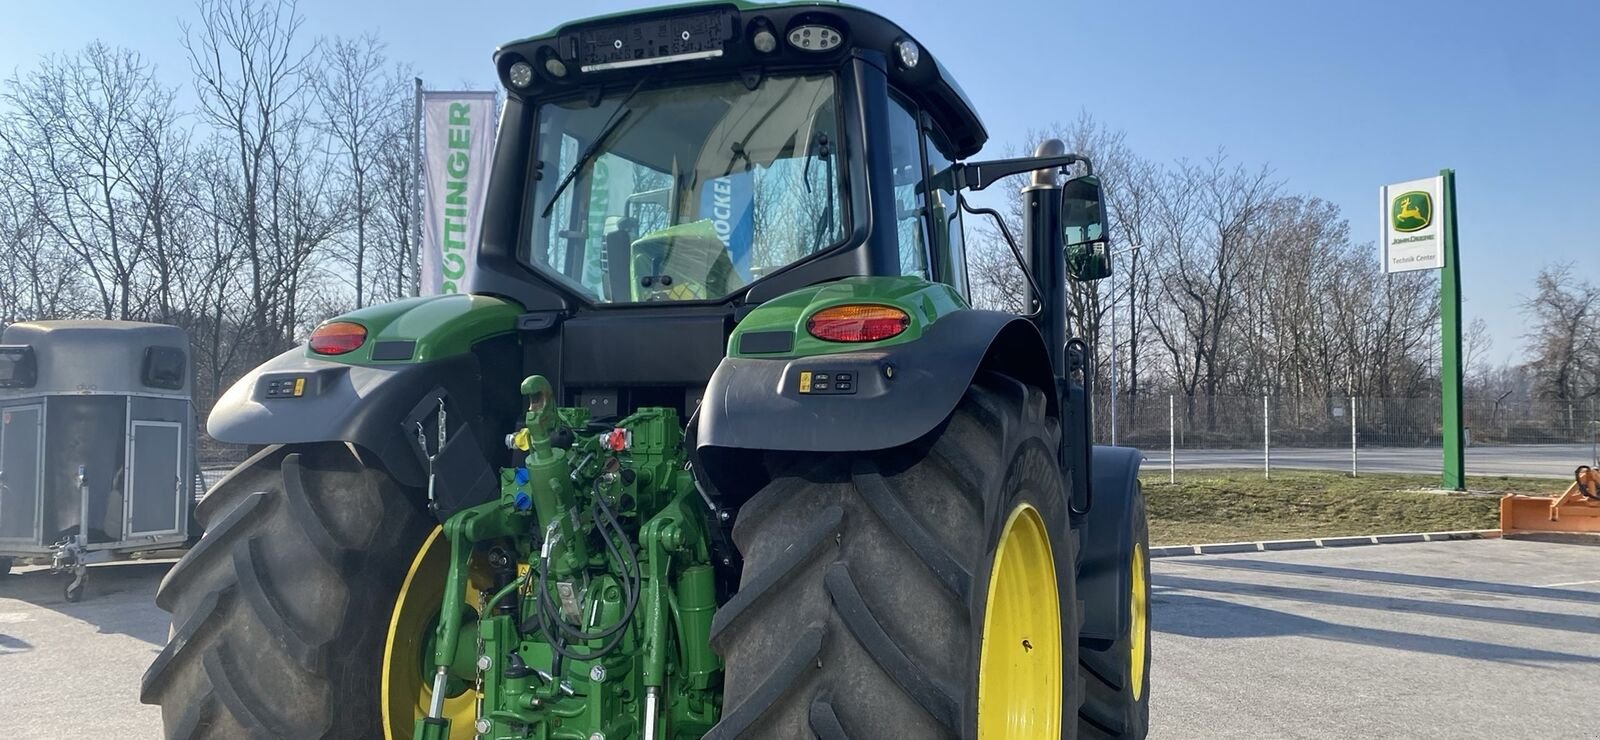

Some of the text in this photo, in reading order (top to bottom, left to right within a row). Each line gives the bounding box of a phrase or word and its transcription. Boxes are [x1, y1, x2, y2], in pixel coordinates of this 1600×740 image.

[1392, 234, 1434, 245] JOHN DEERE
[1392, 254, 1436, 264] Technik Center
